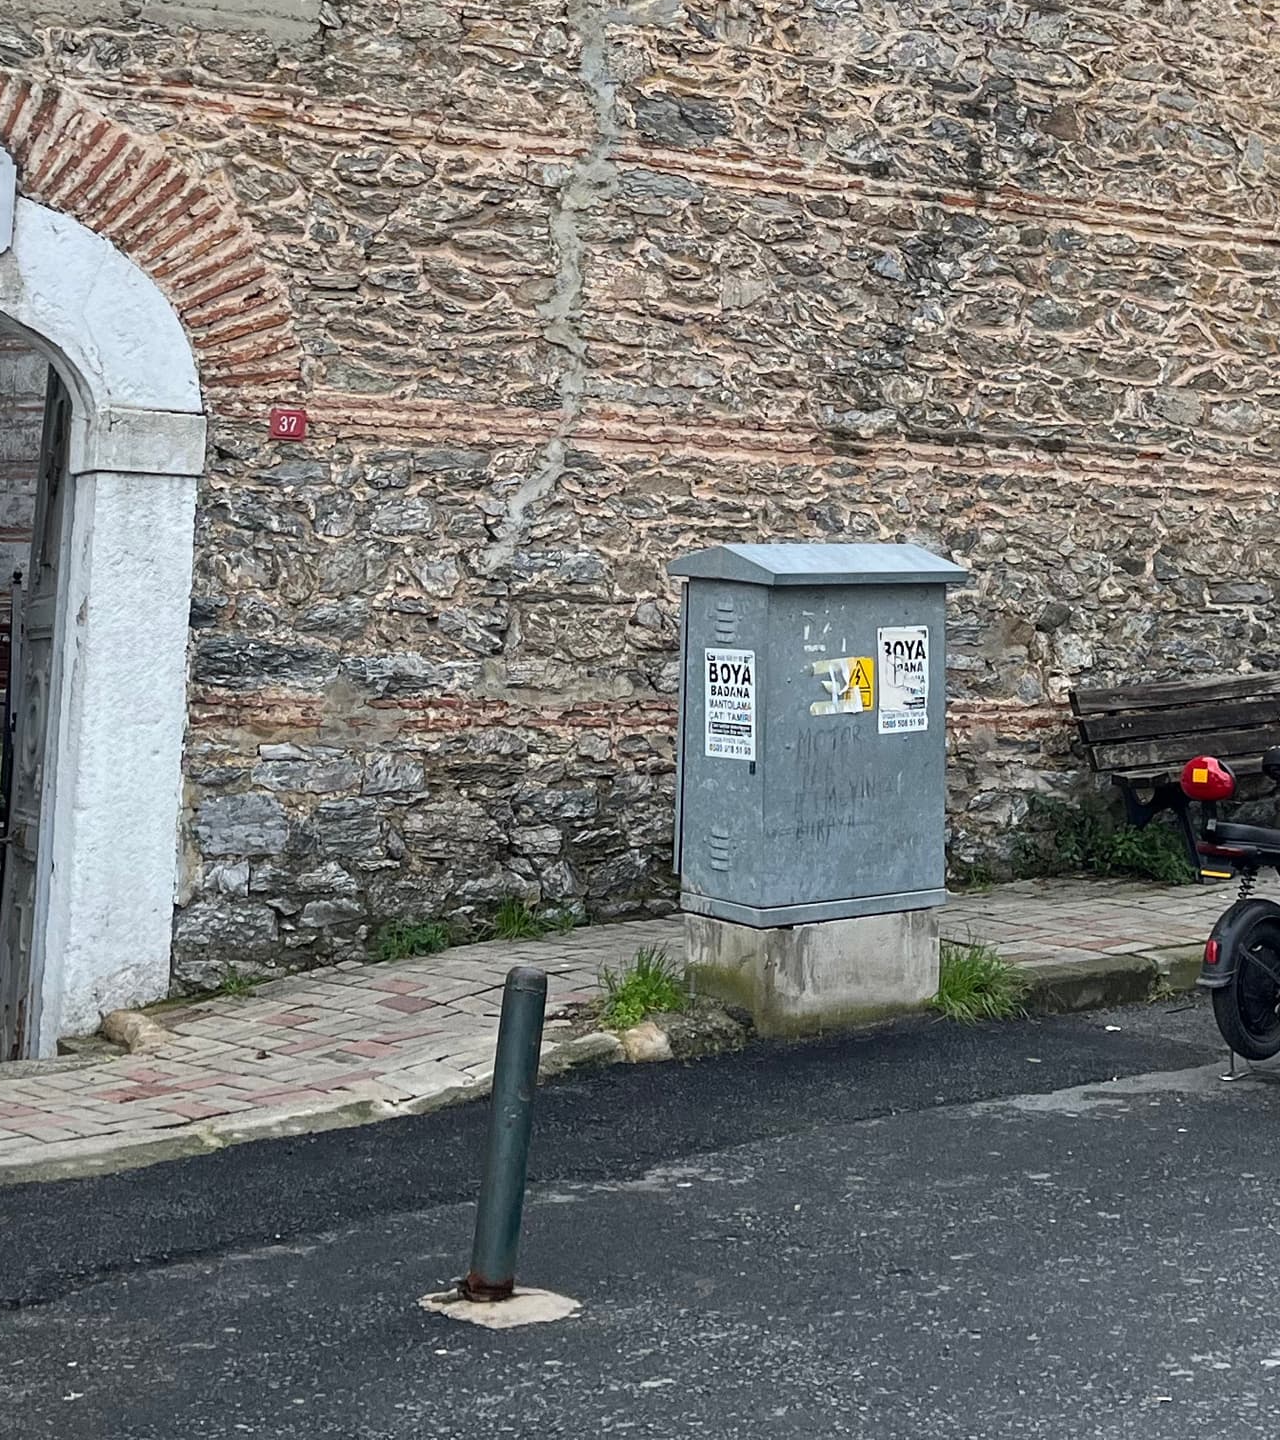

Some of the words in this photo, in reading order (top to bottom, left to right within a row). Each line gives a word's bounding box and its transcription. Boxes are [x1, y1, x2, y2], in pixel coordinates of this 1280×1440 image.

[279, 415, 297, 433] 37
[709, 662, 752, 686] BOYA
[710, 685, 750, 699] BADANA
[709, 698, 752, 711] MANTOLAMA
